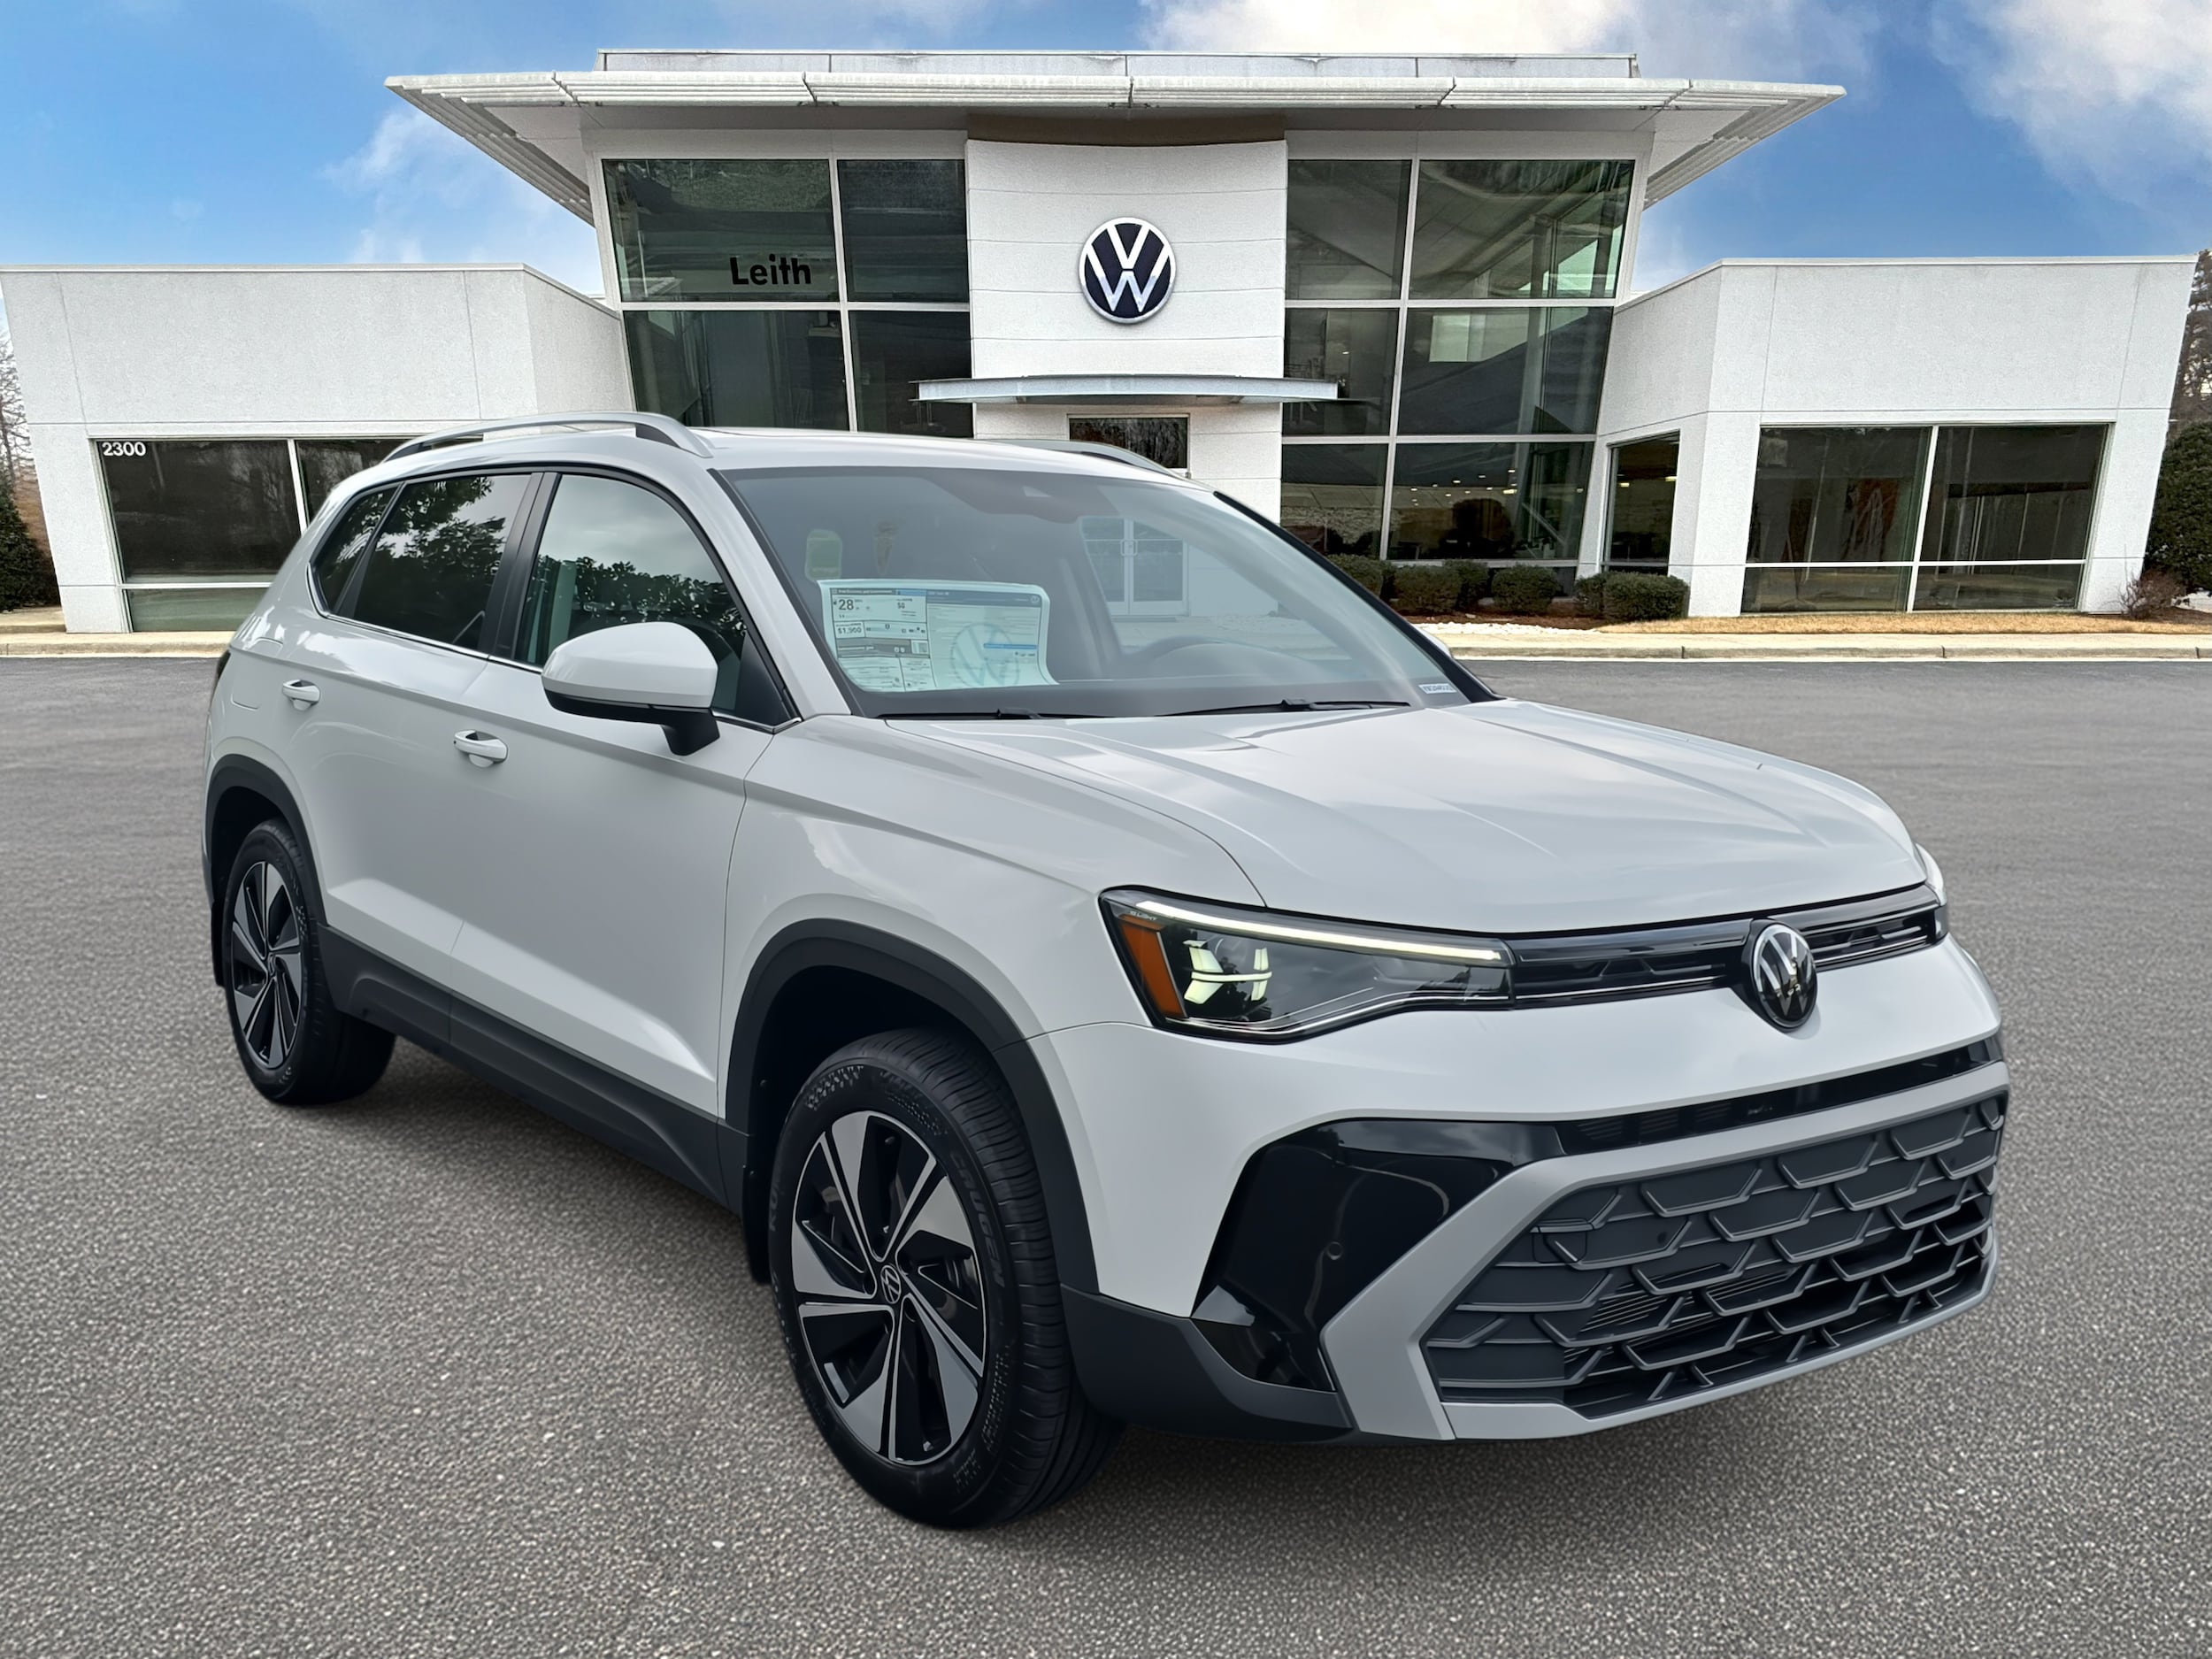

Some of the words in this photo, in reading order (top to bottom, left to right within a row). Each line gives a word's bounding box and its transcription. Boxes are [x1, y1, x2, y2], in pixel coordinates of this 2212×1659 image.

[730, 254, 811, 285] Leith
[102, 442, 146, 457] 2300
[838, 599, 854, 611] 28
